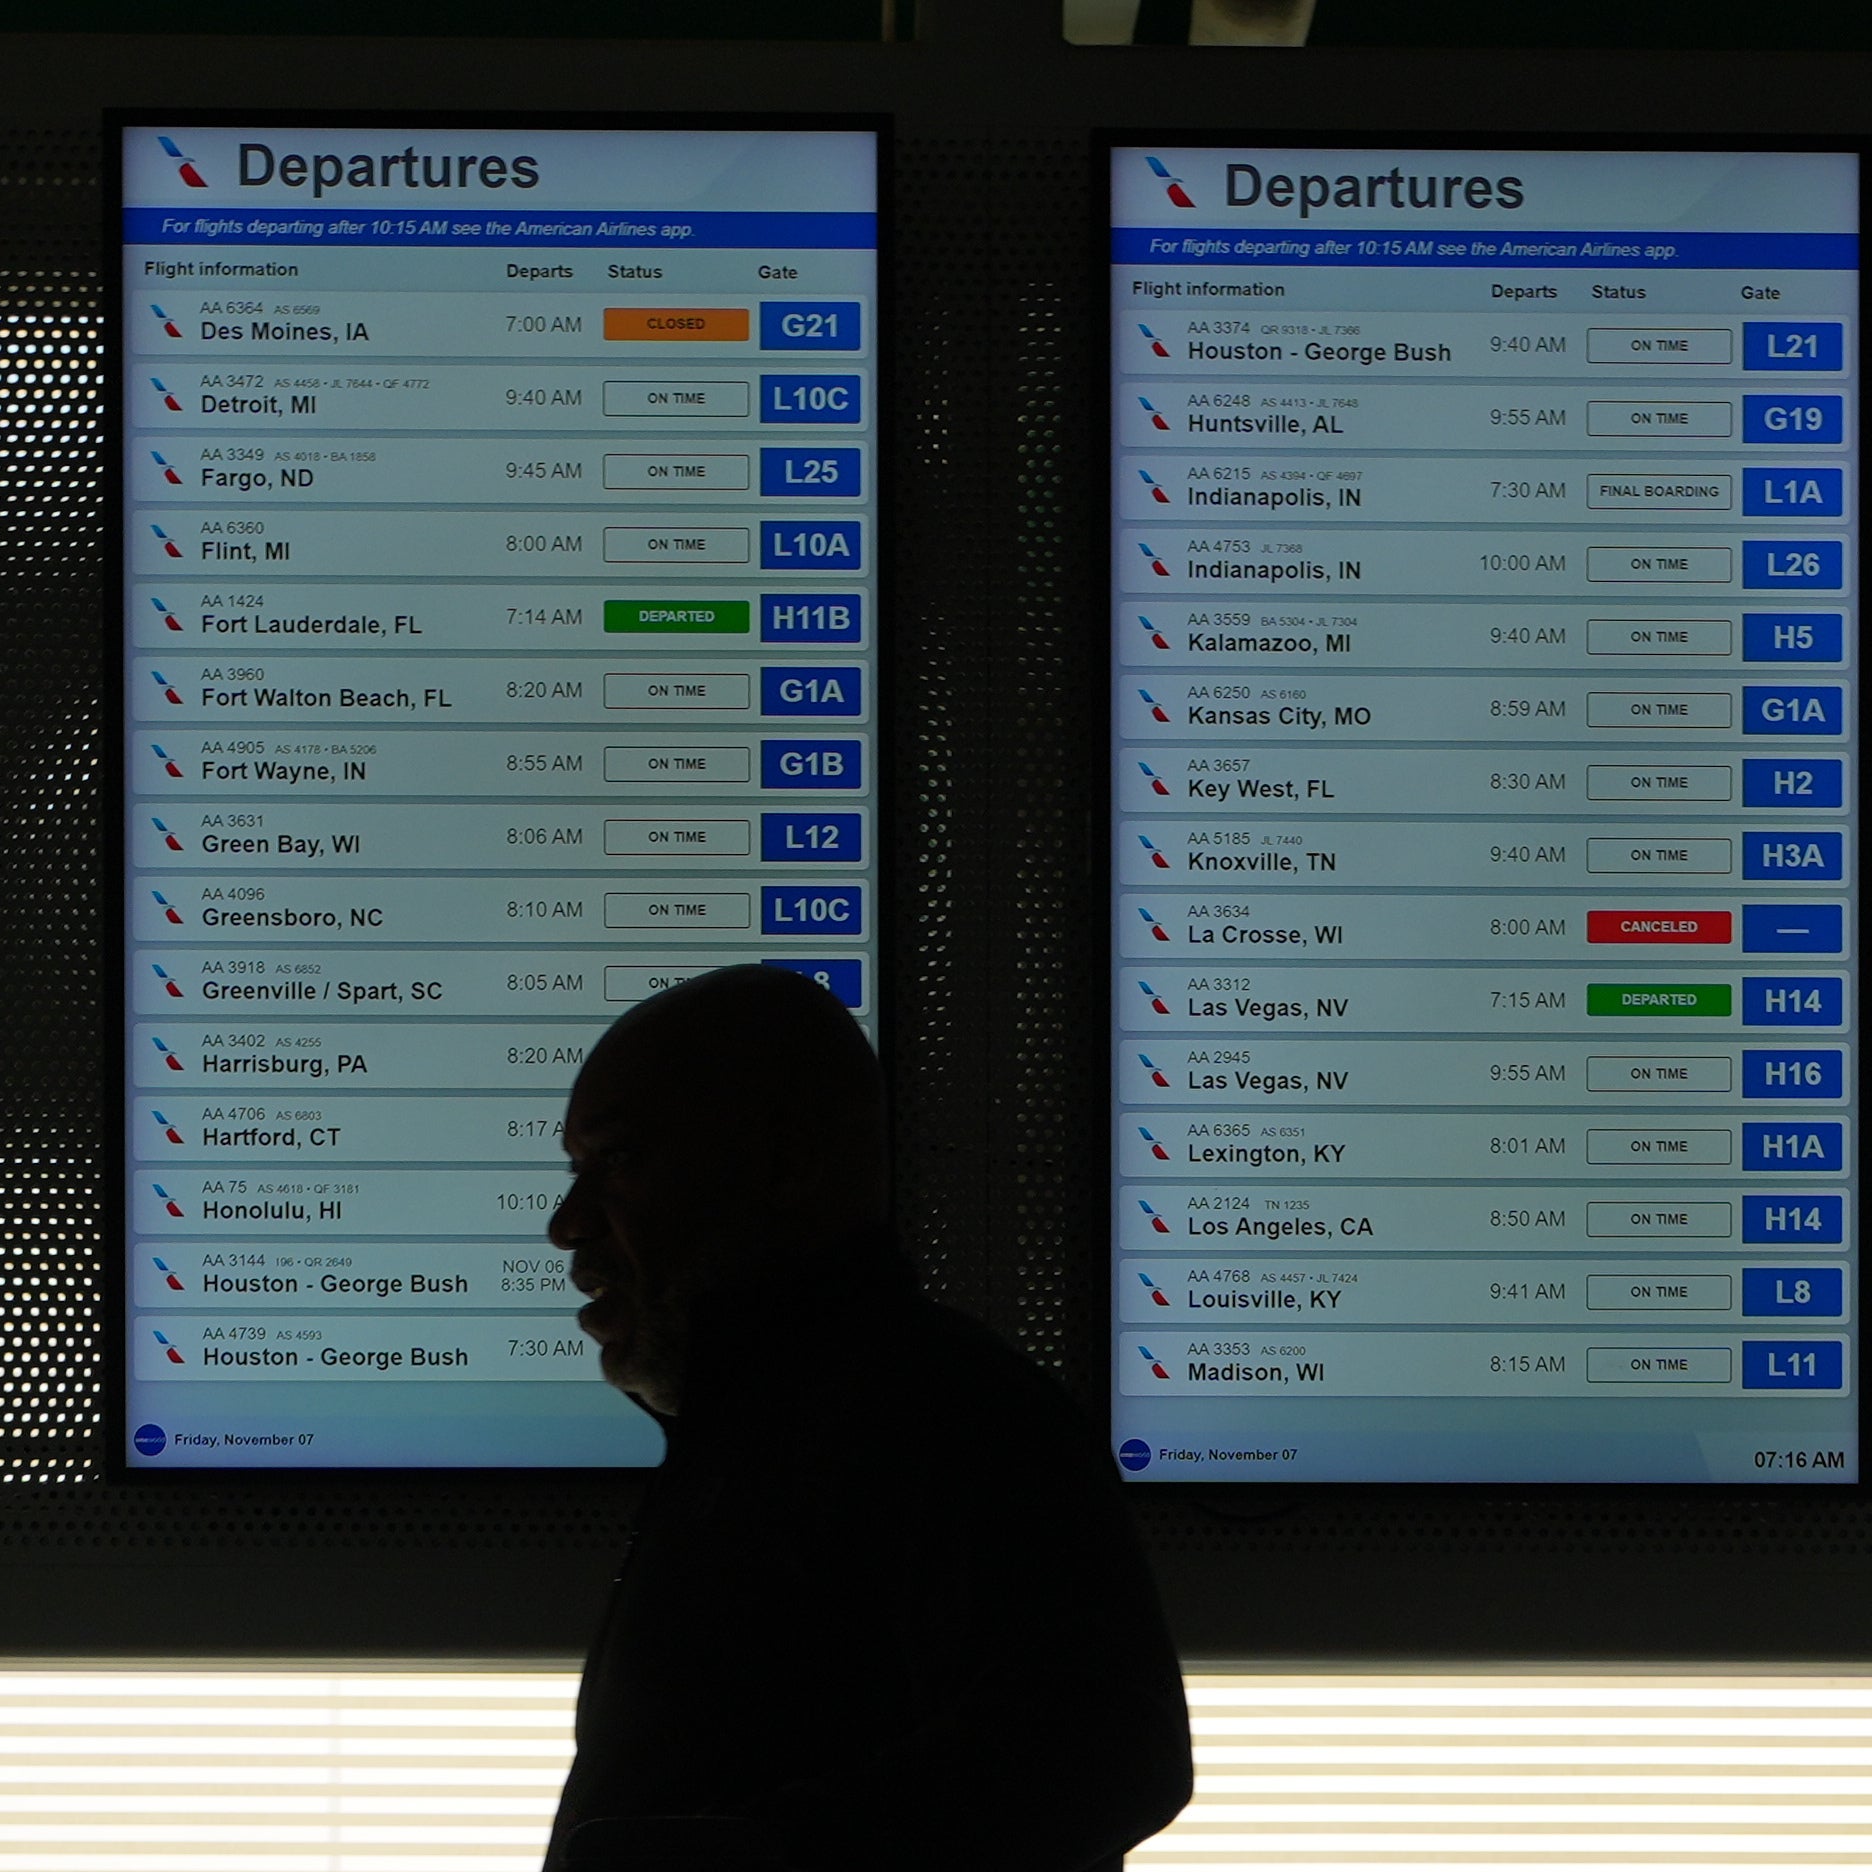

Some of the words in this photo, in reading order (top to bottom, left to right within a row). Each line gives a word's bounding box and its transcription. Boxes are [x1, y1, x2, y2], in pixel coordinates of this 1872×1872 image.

[239, 143, 540, 199] Departures
[1226, 163, 1525, 219] Departures
[201, 321, 244, 340] Des
[251, 321, 339, 345] Moines,
[346, 322, 370, 341] IA
[646, 317, 706, 331] CLOSED
[1188, 414, 1307, 437] Huntsville,
[1311, 415, 1345, 434] AL
[1600, 485, 1641, 497] FINAL
[1644, 485, 1720, 498] BOARDING
[1764, 479, 1824, 504] L1A
[200, 594, 224, 608] AA
[228, 594, 264, 608] 1424
[202, 614, 248, 634] Fort
[255, 614, 387, 638] Lauderdale,
[394, 615, 423, 634] FL
[506, 608, 547, 625] 7:14
[550, 608, 582, 625] AM
[638, 610, 716, 623] DEPARTED
[773, 605, 851, 630] H11B
[1188, 778, 1231, 803] Key
[1236, 779, 1299, 802] West,
[1307, 779, 1335, 799] FL
[1774, 770, 1813, 795] H2
[202, 834, 269, 853] Green
[277, 834, 325, 858] Bay,
[331, 834, 360, 854] WI
[1620, 920, 1699, 933] CANCELED
[1187, 1050, 1210, 1064] AA
[1213, 1050, 1251, 1064] 2945
[1189, 1070, 1228, 1090] Las
[1234, 1071, 1309, 1095] Vegas,
[1317, 1071, 1349, 1090] NV
[1630, 1067, 1651, 1080] ON
[1655, 1067, 1688, 1080] TIME
[1765, 1061, 1822, 1086] H16
[203, 1127, 302, 1150] Hartford,
[309, 1127, 342, 1147] CT
[1188, 1216, 1229, 1236] Los
[1235, 1216, 1333, 1241] Angeles,
[1340, 1217, 1374, 1236] CA
[503, 1259, 541, 1274] NOV
[544, 1259, 565, 1274] 06
[501, 1277, 535, 1292] 8:35
[540, 1277, 566, 1292] PM
[1188, 1362, 1289, 1385] Madison,
[1295, 1362, 1324, 1382] WI
